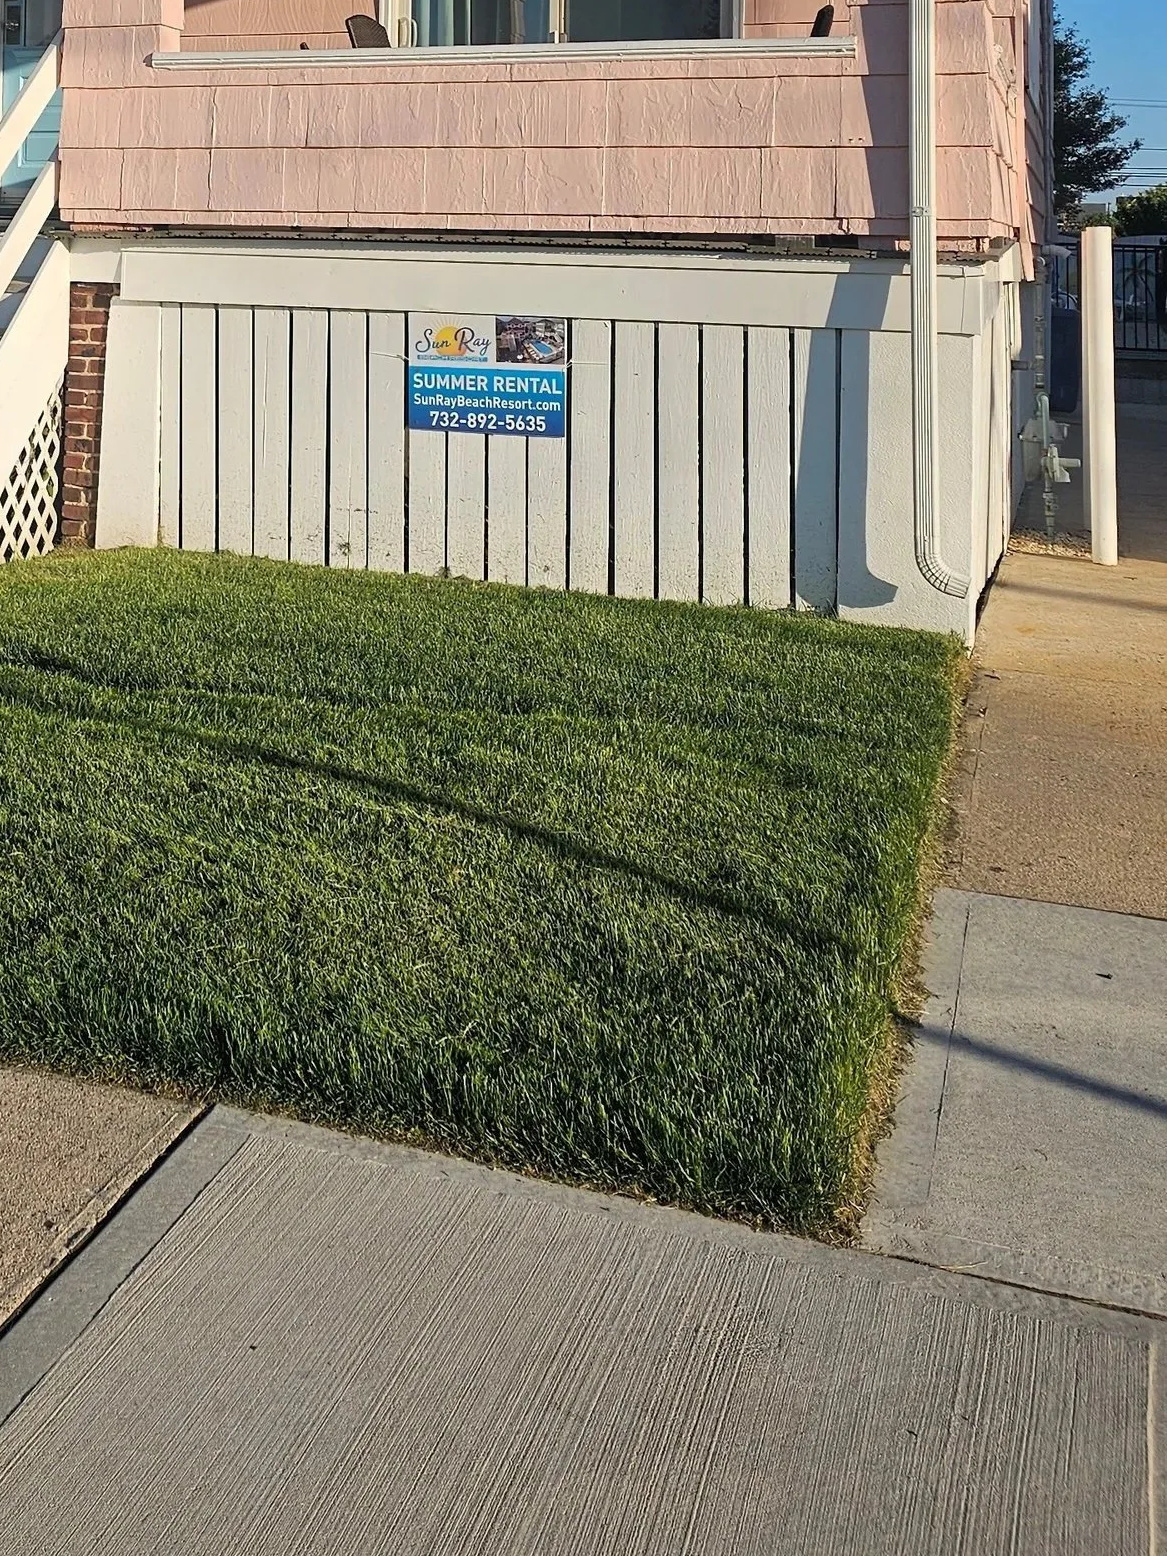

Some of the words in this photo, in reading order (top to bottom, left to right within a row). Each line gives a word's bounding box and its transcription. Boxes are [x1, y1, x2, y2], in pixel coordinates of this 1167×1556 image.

[415, 328, 451, 353] Sun
[454, 327, 492, 356] Ray
[413, 373, 488, 391] SUMMER
[494, 376, 562, 394] RENTAL
[414, 393, 561, 411] SunRayBeachResort.com
[430, 411, 546, 432] 732-892-5635
